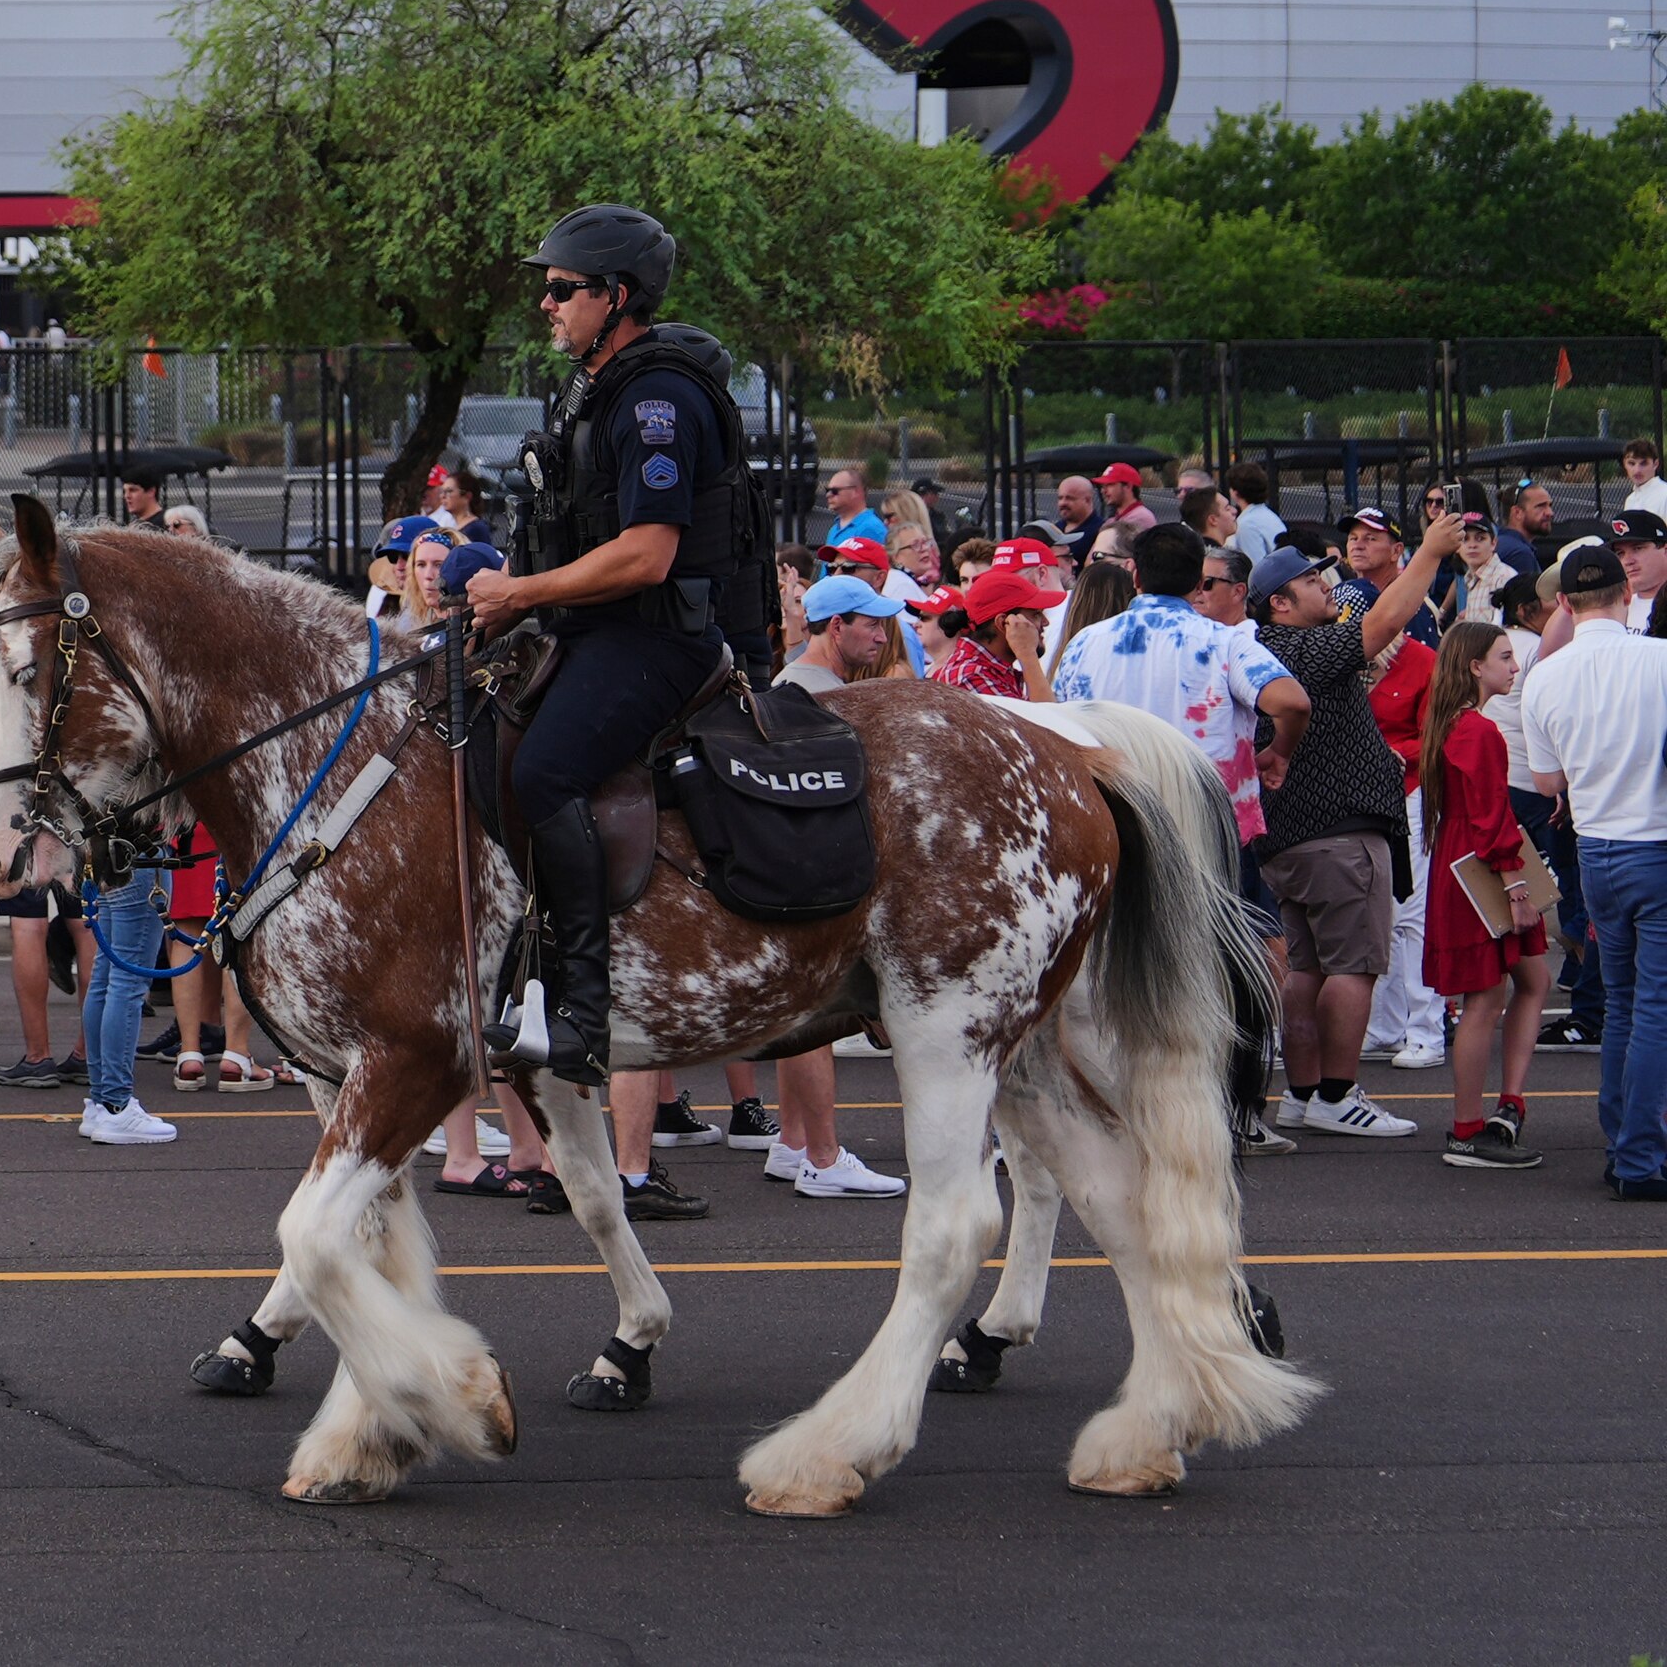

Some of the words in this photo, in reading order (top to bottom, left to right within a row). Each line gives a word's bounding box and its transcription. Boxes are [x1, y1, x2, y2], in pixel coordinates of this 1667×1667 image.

[637, 401, 673, 411] POLICE
[730, 758, 846, 791] POLICE
[1448, 1141, 1475, 1153] HOKA
